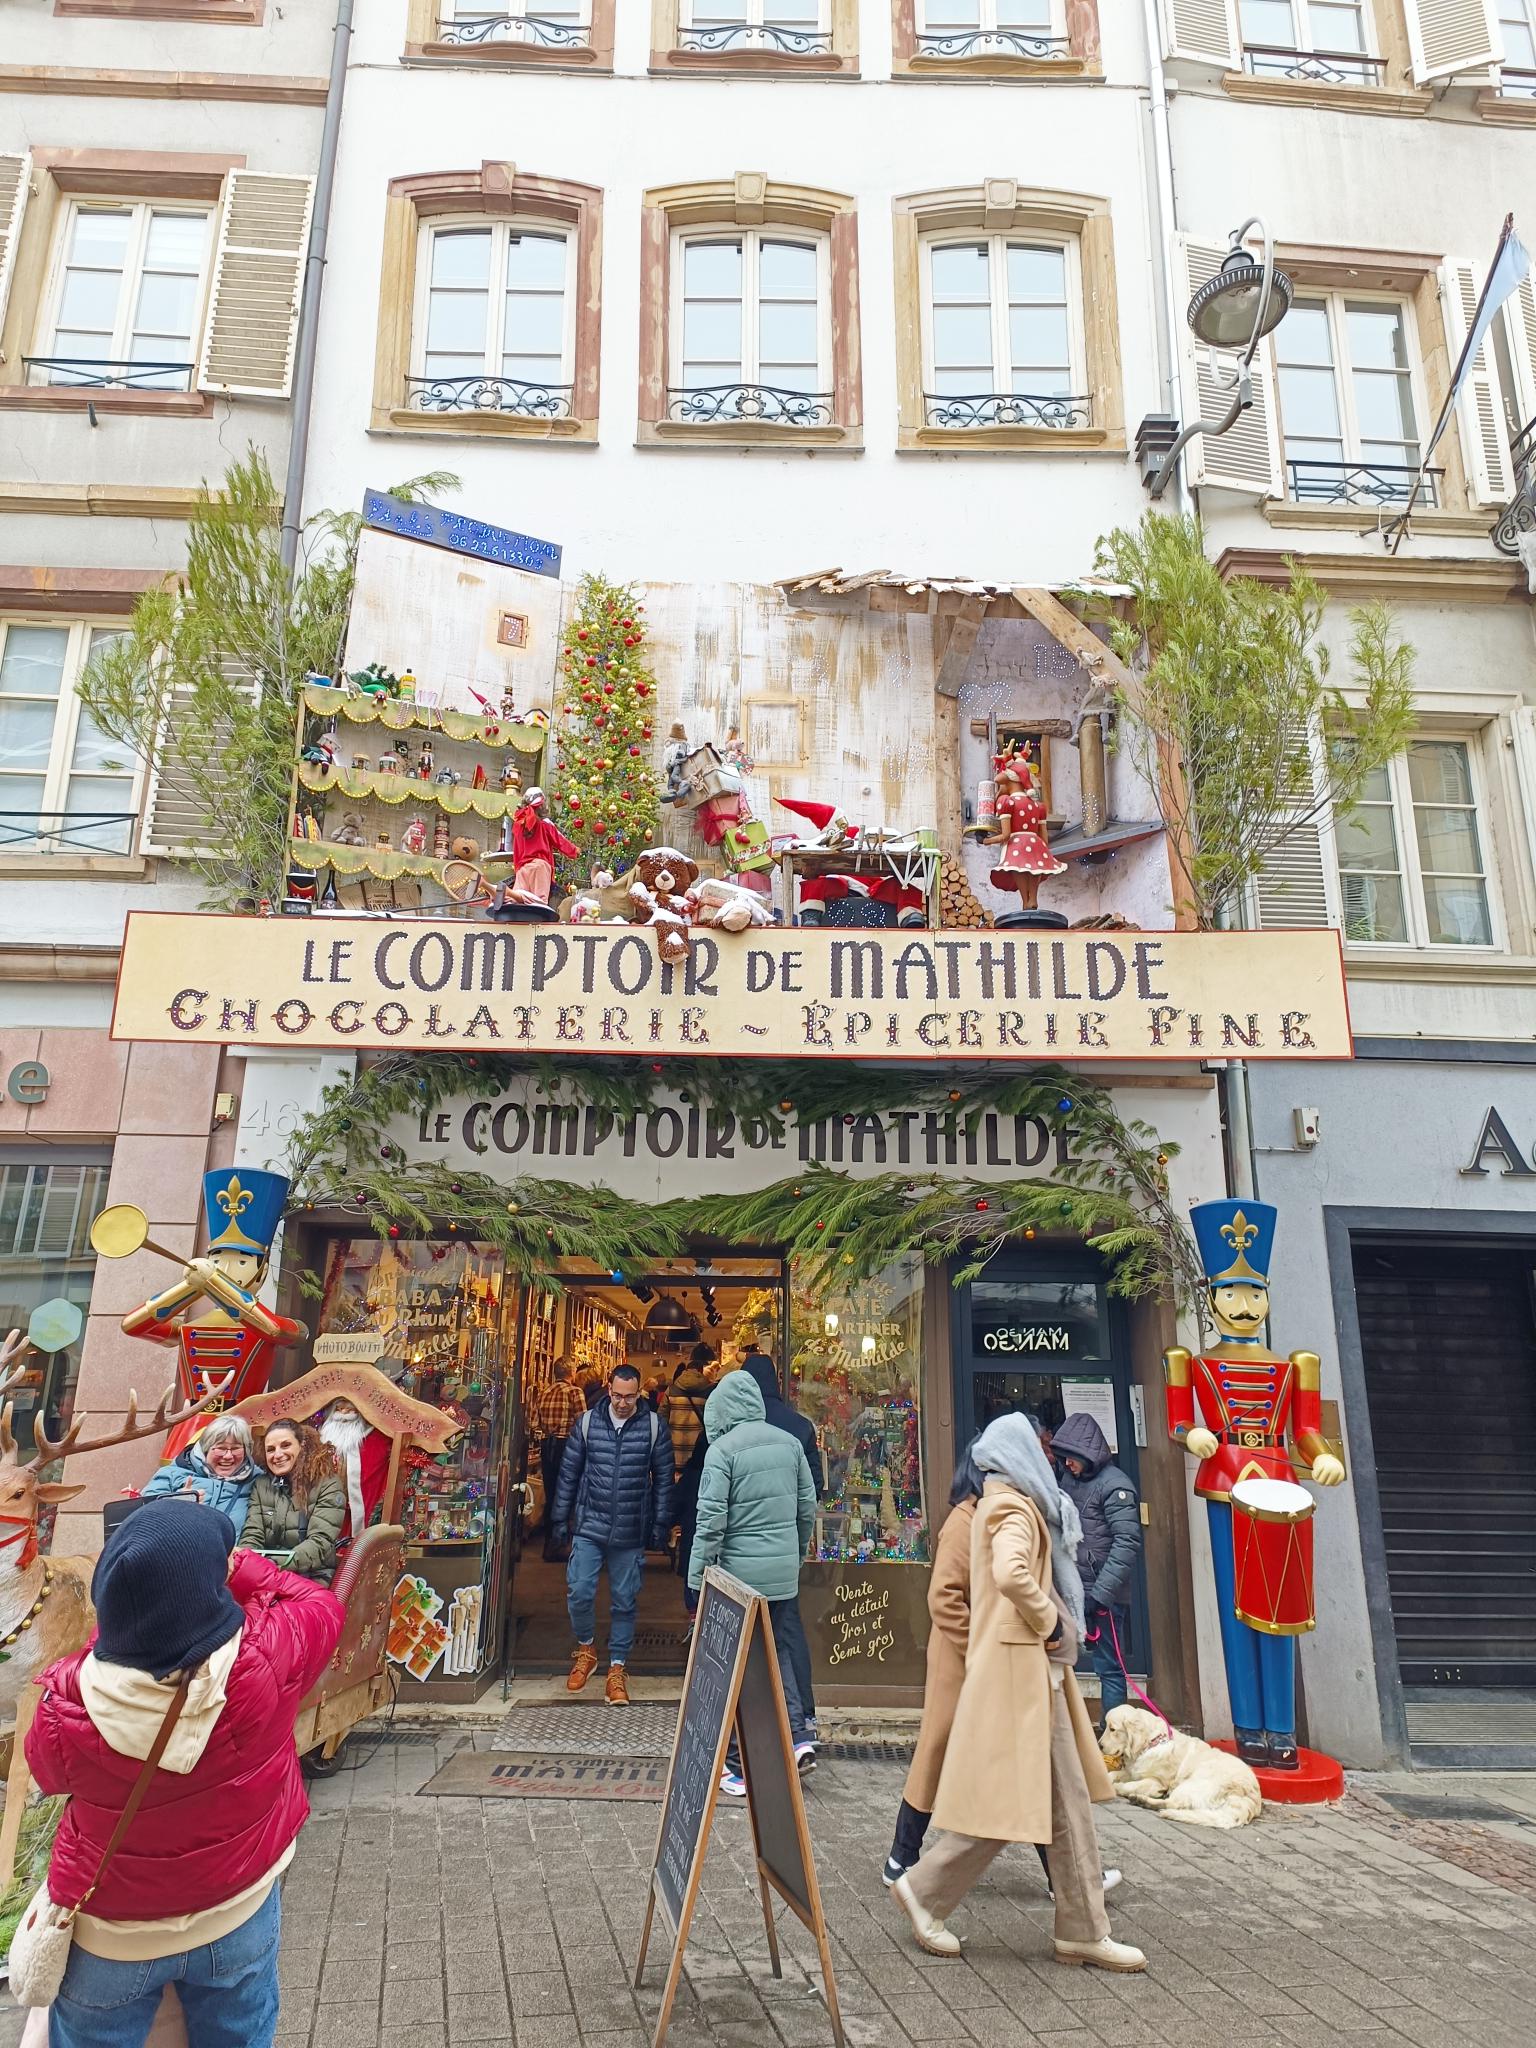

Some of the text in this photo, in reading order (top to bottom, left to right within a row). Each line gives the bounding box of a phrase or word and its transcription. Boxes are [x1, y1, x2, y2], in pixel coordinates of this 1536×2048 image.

[302, 931, 1169, 1000] LE COMPTOIR DE MATHILDE
[166, 988, 711, 1045] CHOCOLATERIE
[1148, 1005, 1318, 1049] FINE
[240, 1099, 300, 1137] 46
[419, 1113, 451, 1143] LE
[462, 1102, 735, 1158] COMPTOIR
[750, 1118, 787, 1150] DE
[379, 1288, 442, 1306] BABA
[830, 1590, 889, 1625] au détail
[835, 1581, 875, 1602] Vente
[872, 1613, 885, 1630] et
[829, 1630, 894, 1665] Semi gros
[490, 1764, 666, 1783] MATHIL
